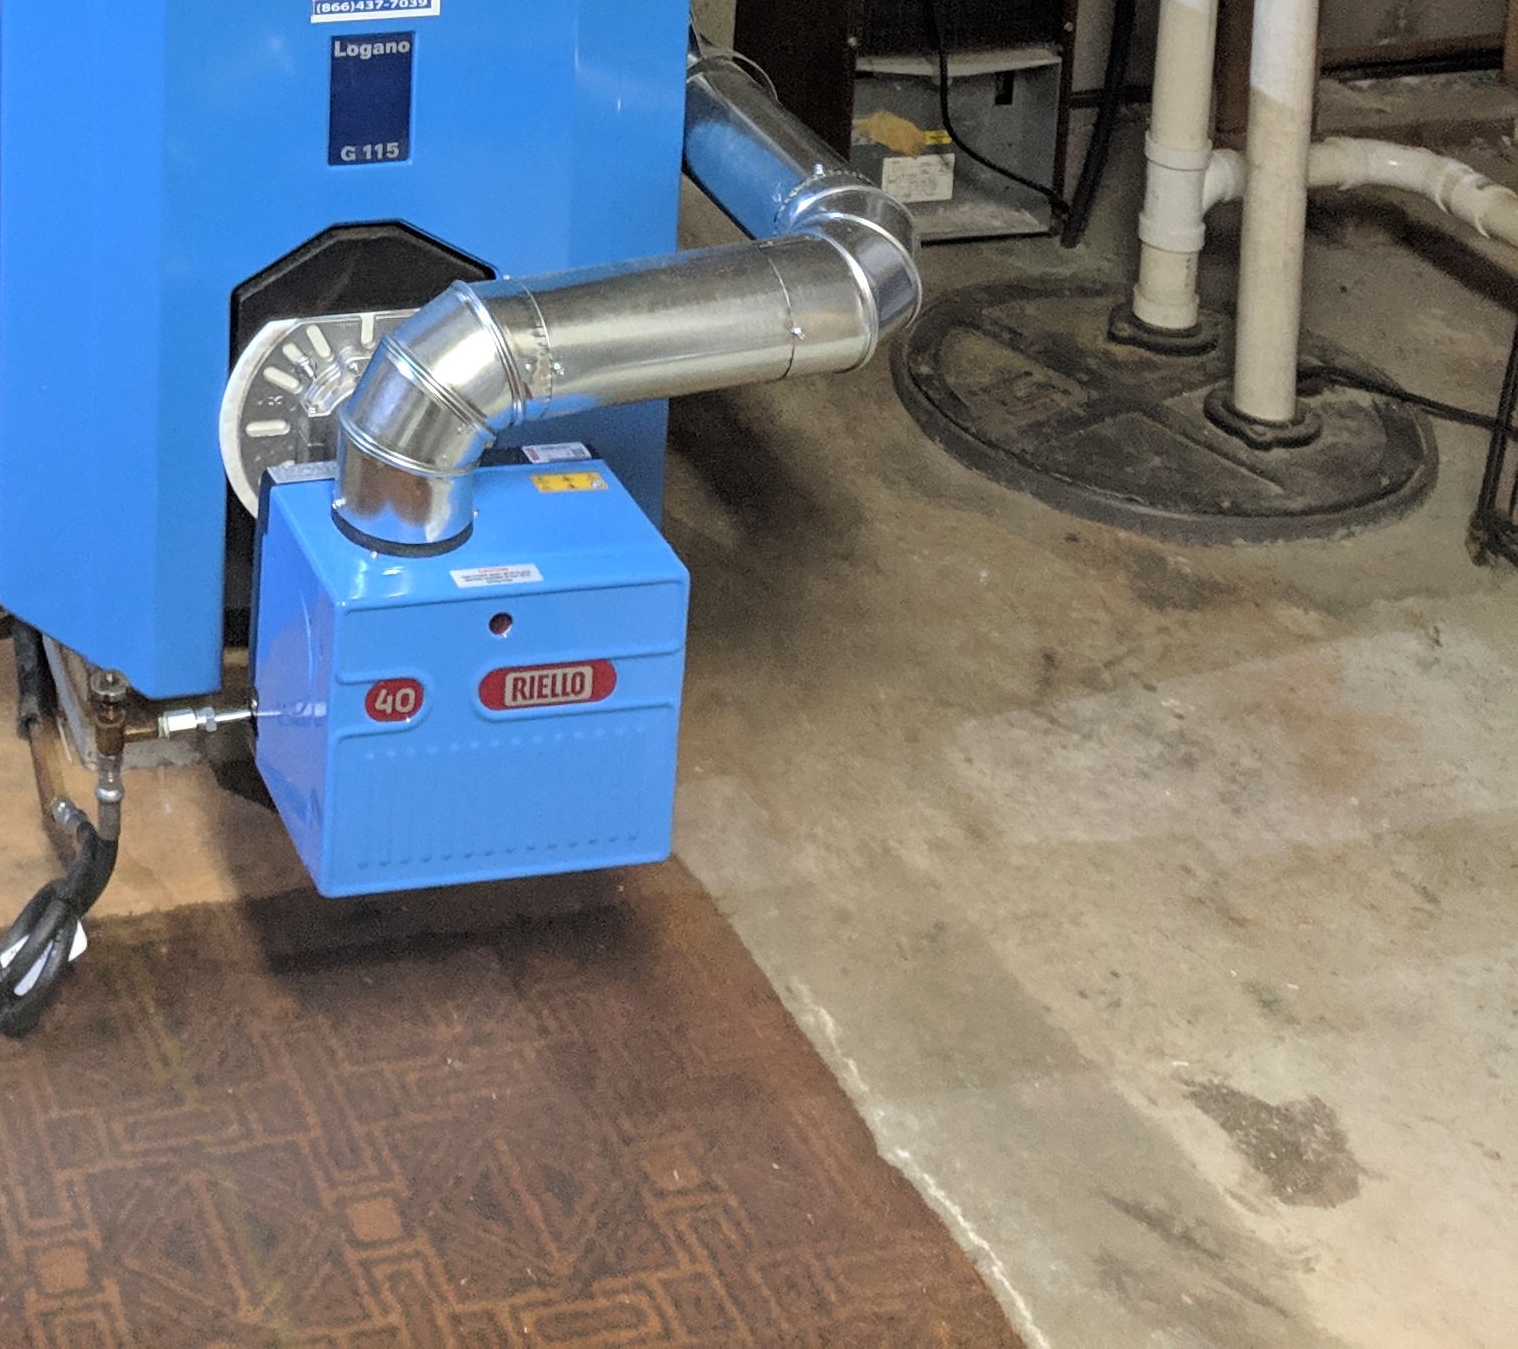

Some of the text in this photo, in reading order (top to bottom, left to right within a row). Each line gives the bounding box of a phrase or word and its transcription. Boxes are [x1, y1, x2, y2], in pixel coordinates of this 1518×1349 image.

[333, 38, 412, 62] Logano
[340, 142, 401, 162] G 115
[510, 669, 588, 703] RIELLO
[374, 686, 417, 717] 40
